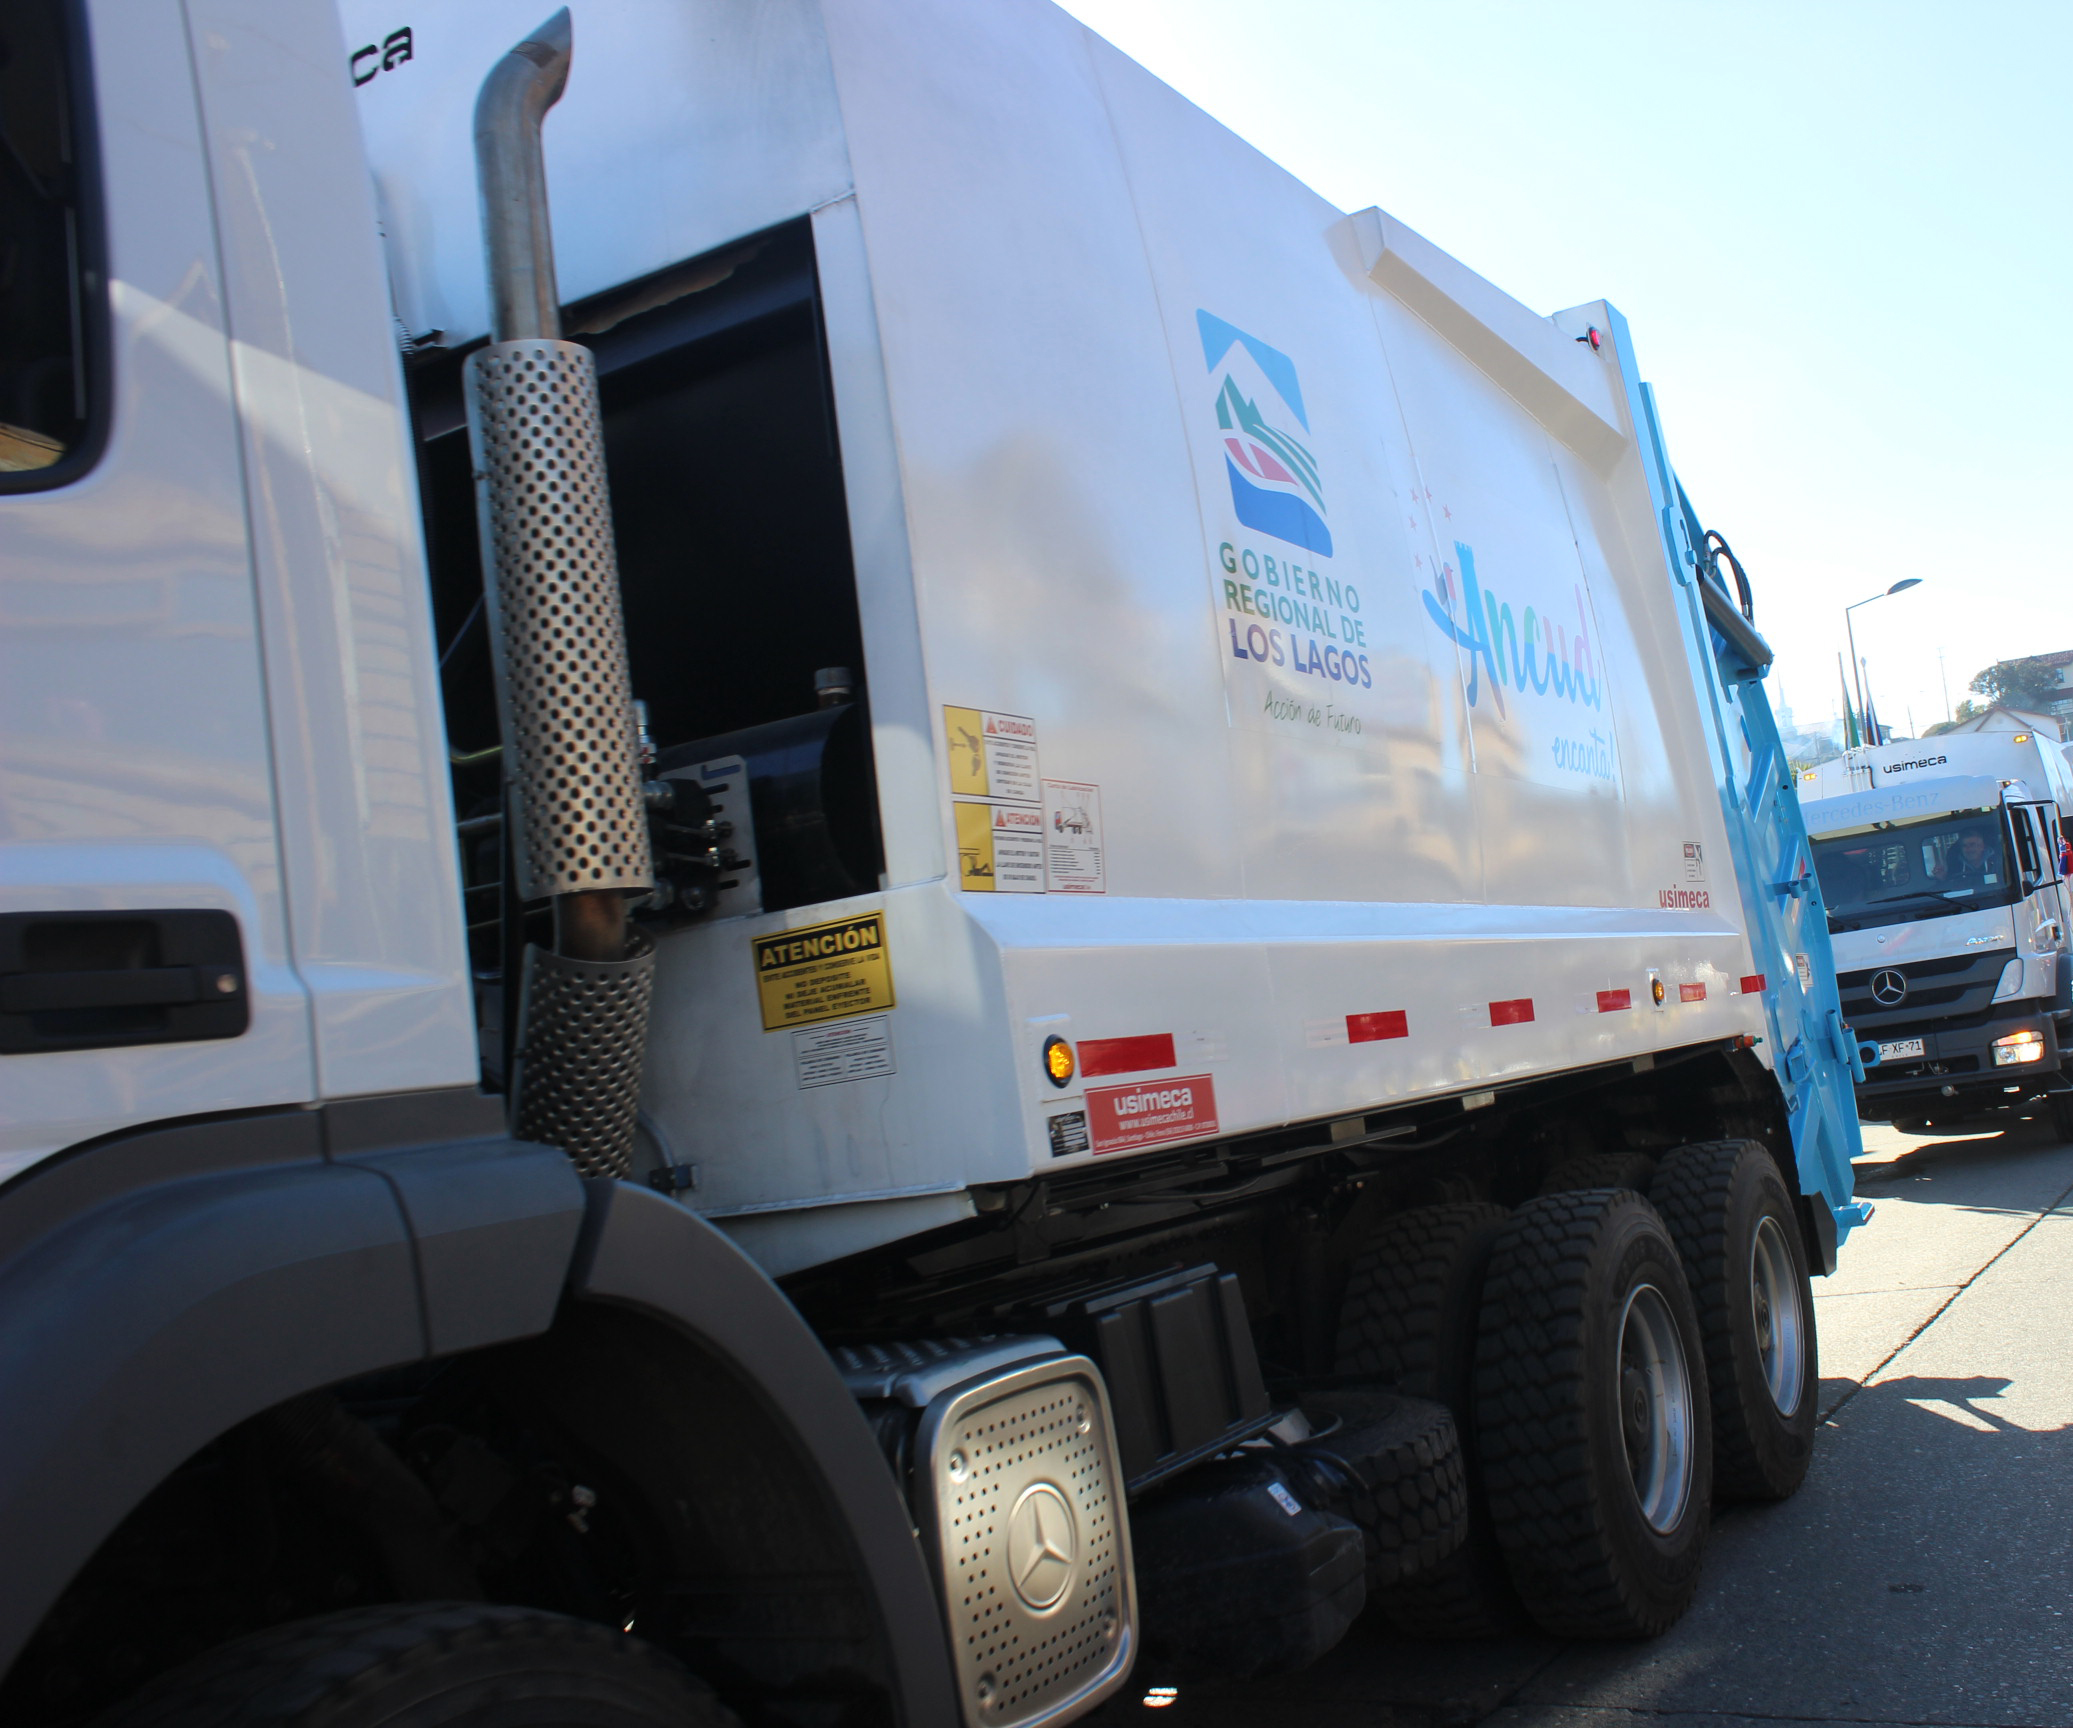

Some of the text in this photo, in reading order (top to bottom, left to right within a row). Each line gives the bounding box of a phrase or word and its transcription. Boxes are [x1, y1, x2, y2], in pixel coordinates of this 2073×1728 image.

[1219, 542, 1360, 613] GOBIERNO
[1223, 579, 1367, 648] REGIONAL DE
[1422, 540, 1601, 721] Ancud
[1229, 618, 1372, 689] LOS LAGOS
[998, 719, 1034, 737] CUIDADO
[1264, 690, 1361, 735] Acción de Futuro
[1883, 755, 1948, 774] usimeca
[1803, 793, 1939, 826] ercedes-Benz
[1659, 884, 1710, 909] usimeca
[761, 925, 878, 967] ATENCIÓN
[1113, 1087, 1193, 1116] usimeca
